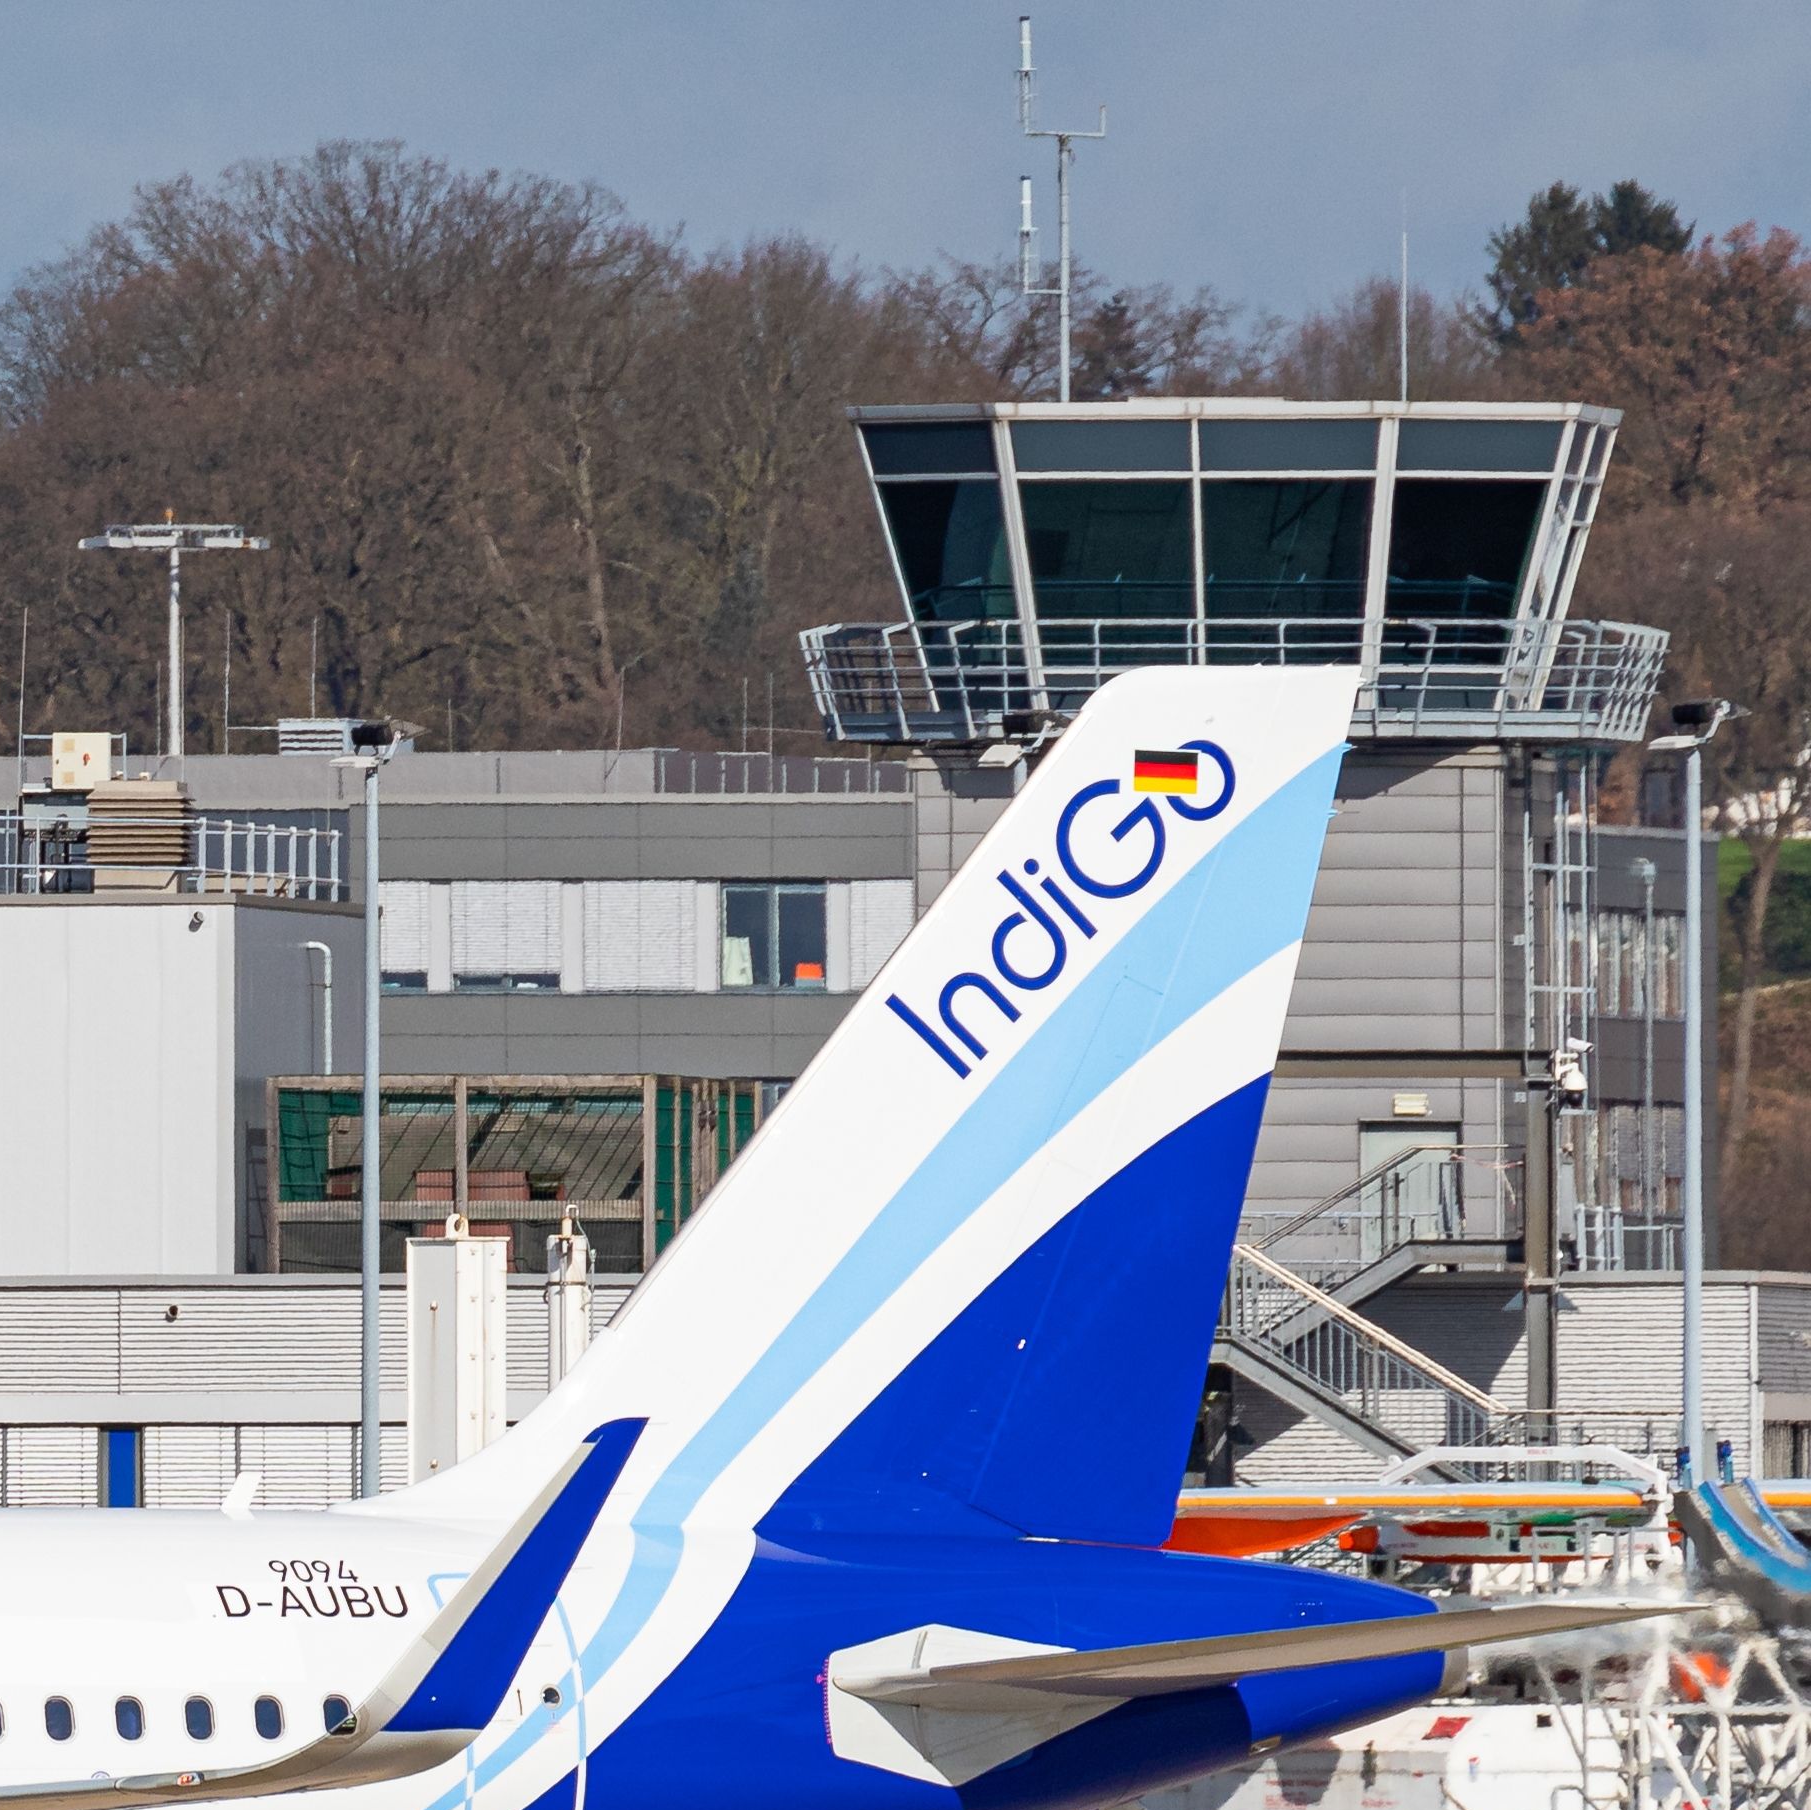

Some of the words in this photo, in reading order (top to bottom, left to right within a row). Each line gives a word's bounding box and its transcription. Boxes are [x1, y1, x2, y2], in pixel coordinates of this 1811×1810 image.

[885, 739, 1236, 1080] IndiGo
[268, 1560, 359, 1582] 9094
[216, 1585, 408, 1618] D-AUBU
